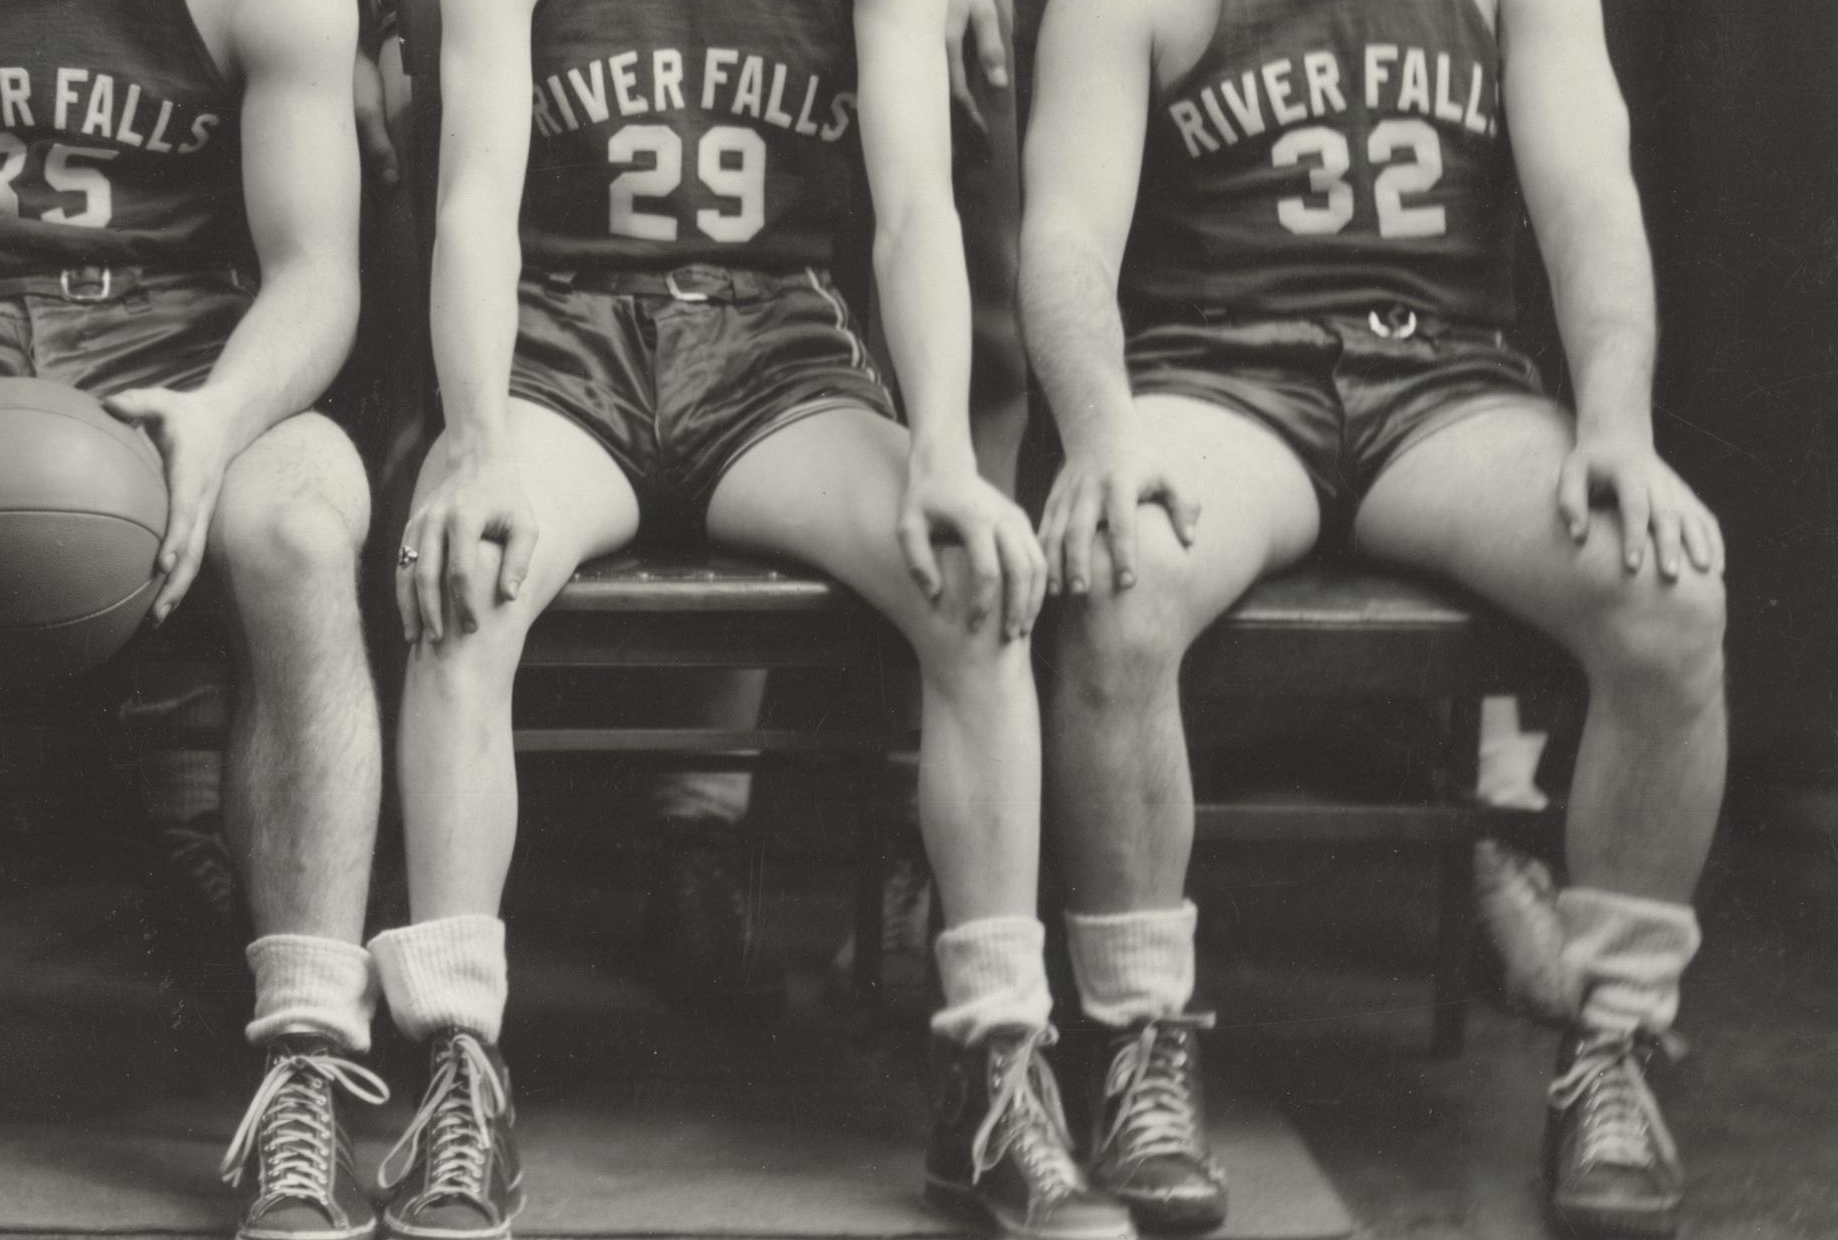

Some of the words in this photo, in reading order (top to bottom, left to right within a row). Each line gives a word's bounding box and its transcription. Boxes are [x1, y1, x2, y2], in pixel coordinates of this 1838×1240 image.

[54, 67, 220, 154] FALLS
[533, 48, 685, 137] RIVER
[701, 47, 858, 142] FALLS
[1169, 49, 1346, 158] RIVER
[1365, 44, 1498, 139] FALL
[608, 124, 766, 243] 29
[1271, 119, 1446, 239] 32
